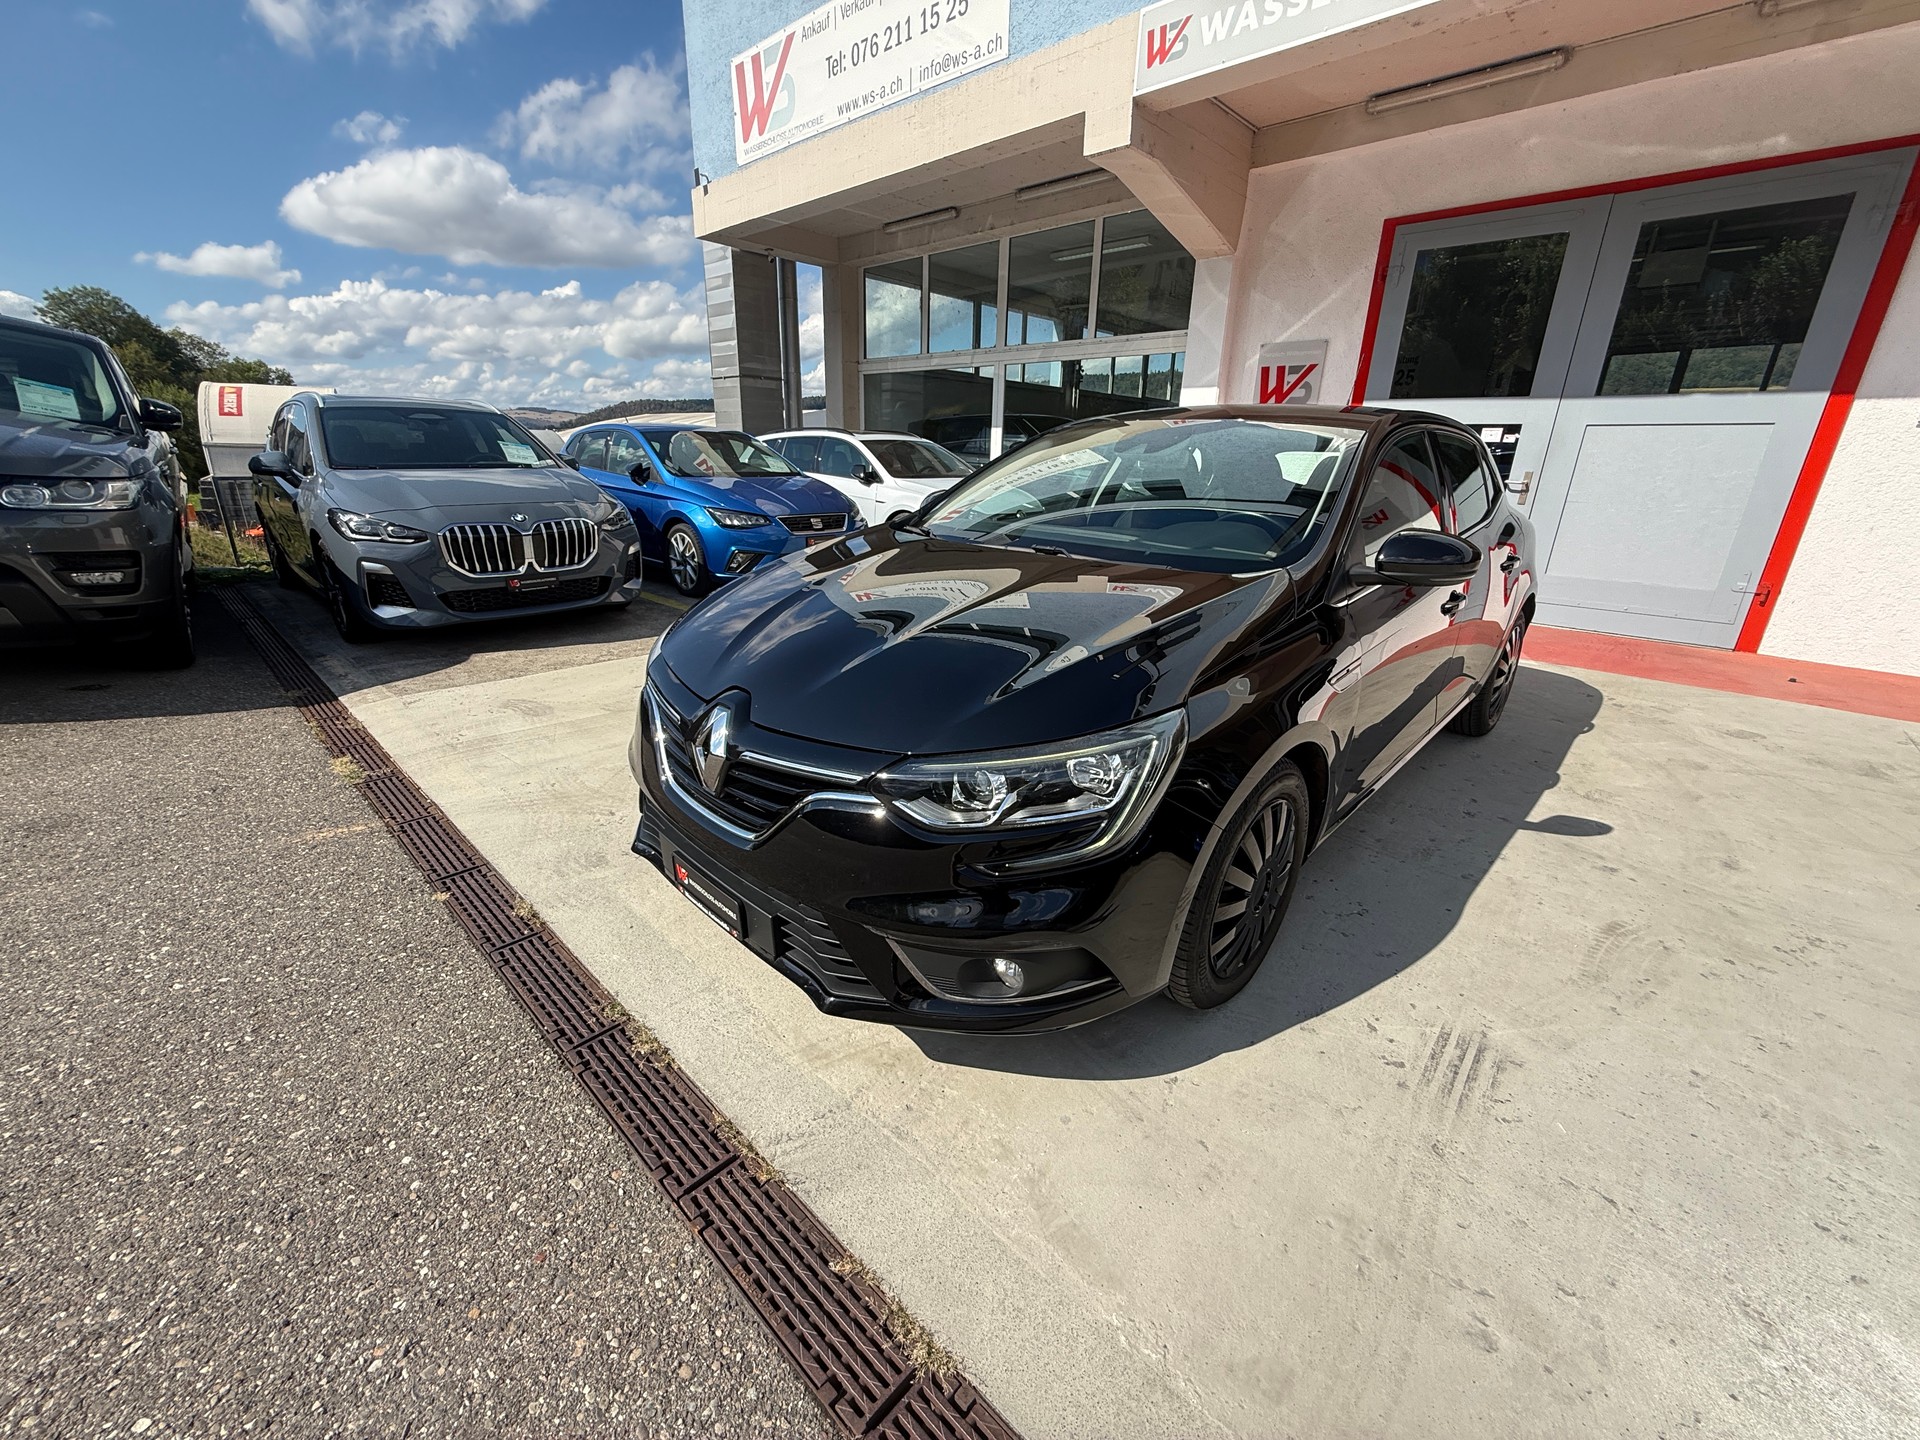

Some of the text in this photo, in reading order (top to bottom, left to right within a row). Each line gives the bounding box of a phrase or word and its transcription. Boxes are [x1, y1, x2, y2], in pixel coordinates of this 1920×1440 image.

[801, 11, 830, 43] Ankauf
[840, 0, 874, 20] Verkau
[826, 0, 969, 79] Tel: 076 211 15 25
[837, 75, 903, 117] www.ws-a.ch
[919, 32, 1003, 84] info@ws-a.ch
[787, 114, 824, 140] AUTOMOBILE
